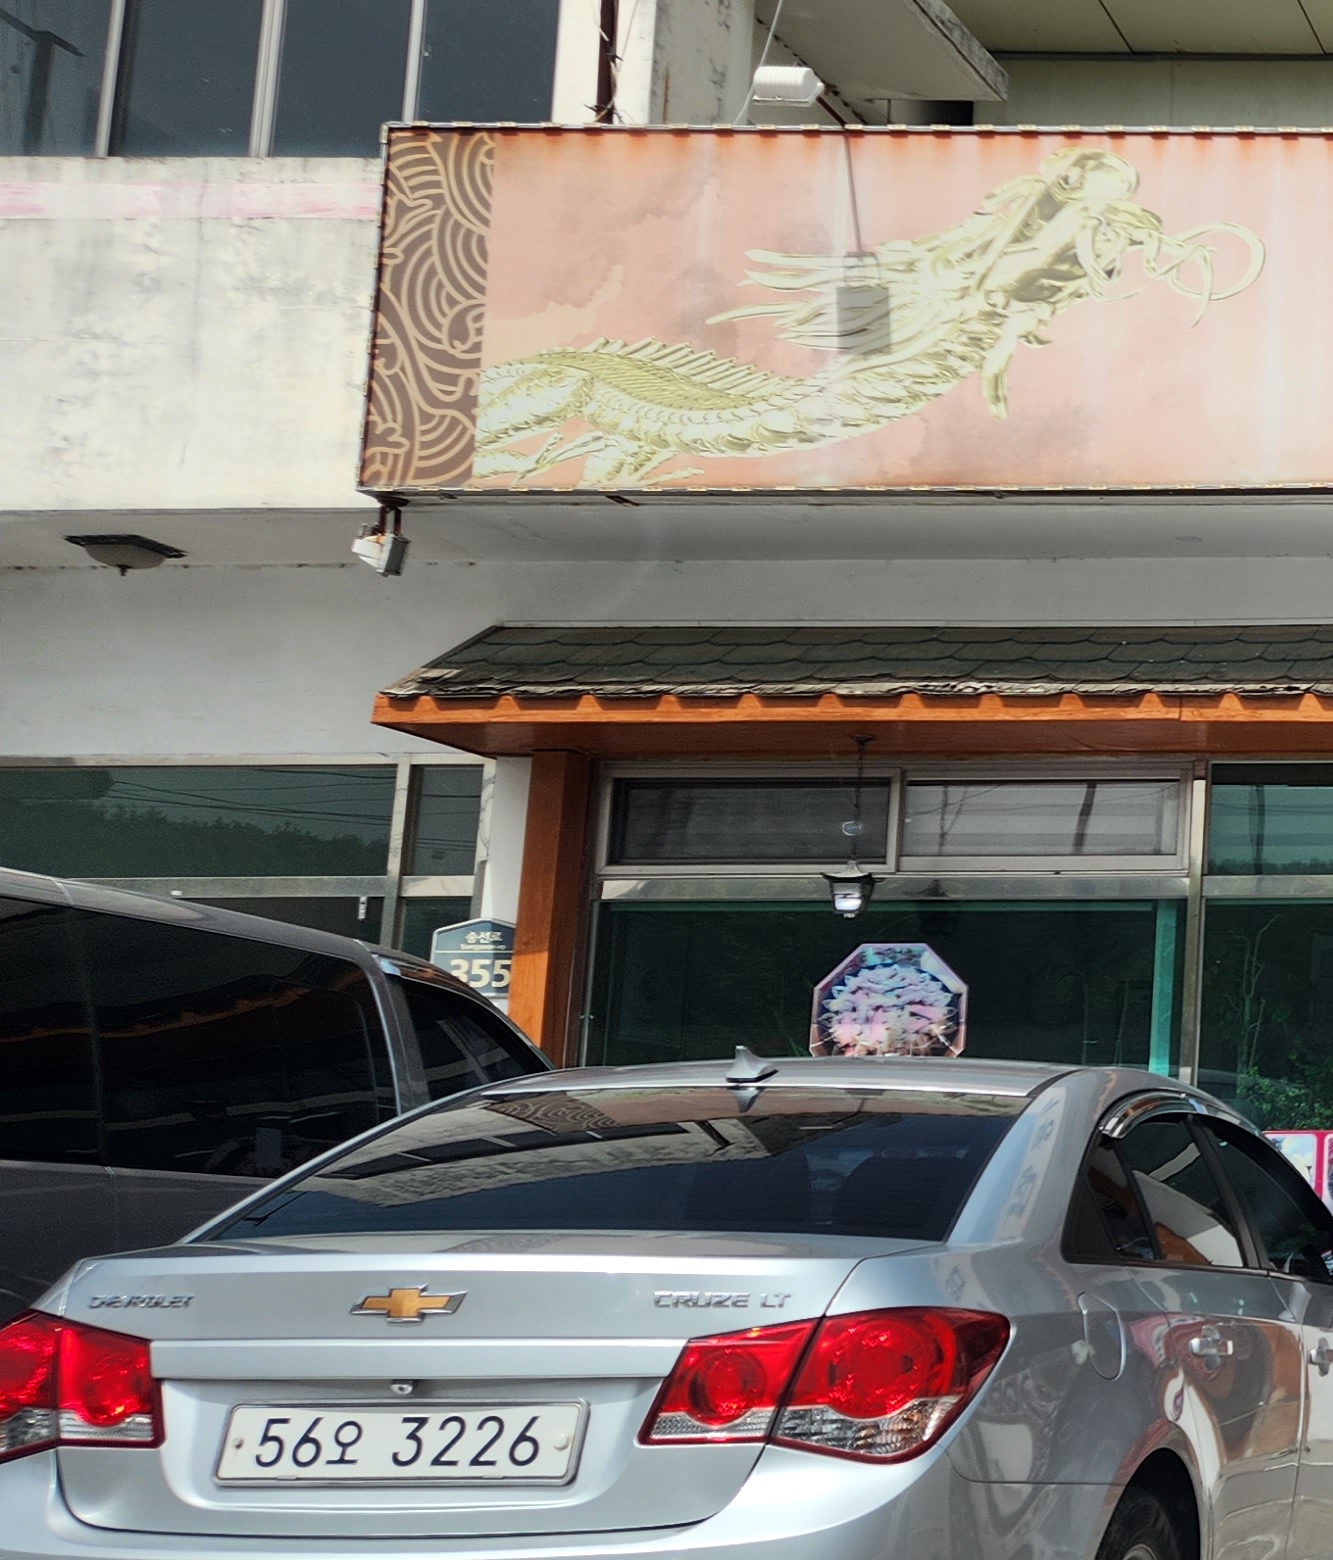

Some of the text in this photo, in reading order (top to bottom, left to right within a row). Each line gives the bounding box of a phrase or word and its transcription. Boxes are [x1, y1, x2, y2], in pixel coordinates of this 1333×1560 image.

[450, 958, 512, 988] 355
[653, 1291, 792, 1308] CRUZE LT
[255, 1415, 541, 1467] 56오 3226
